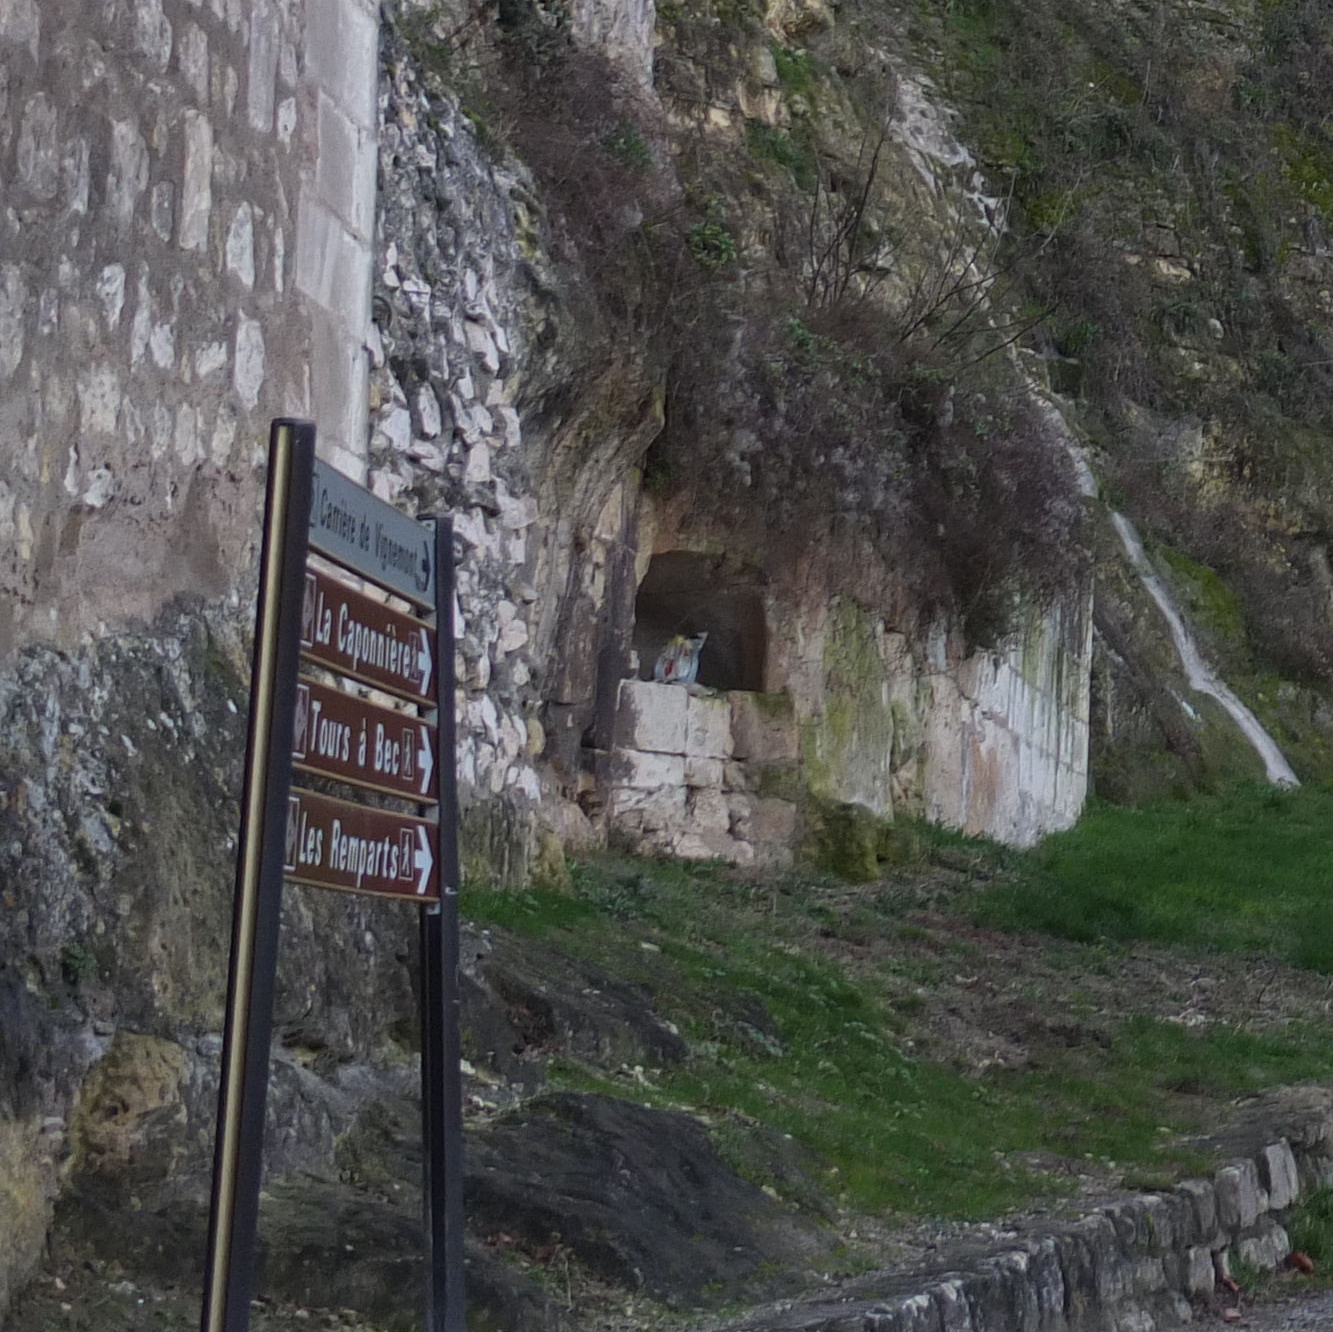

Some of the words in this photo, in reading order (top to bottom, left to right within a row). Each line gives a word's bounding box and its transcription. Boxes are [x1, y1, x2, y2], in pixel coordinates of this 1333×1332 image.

[320, 488, 356, 544] Carrière
[360, 513, 371, 552] de
[316, 591, 332, 645] La
[338, 602, 411, 679] Caponnière
[311, 700, 351, 762] Tours
[358, 717, 368, 767] à
[375, 723, 400, 776] Bec
[298, 810, 323, 866] Les
[329, 818, 400, 888] Remparts
